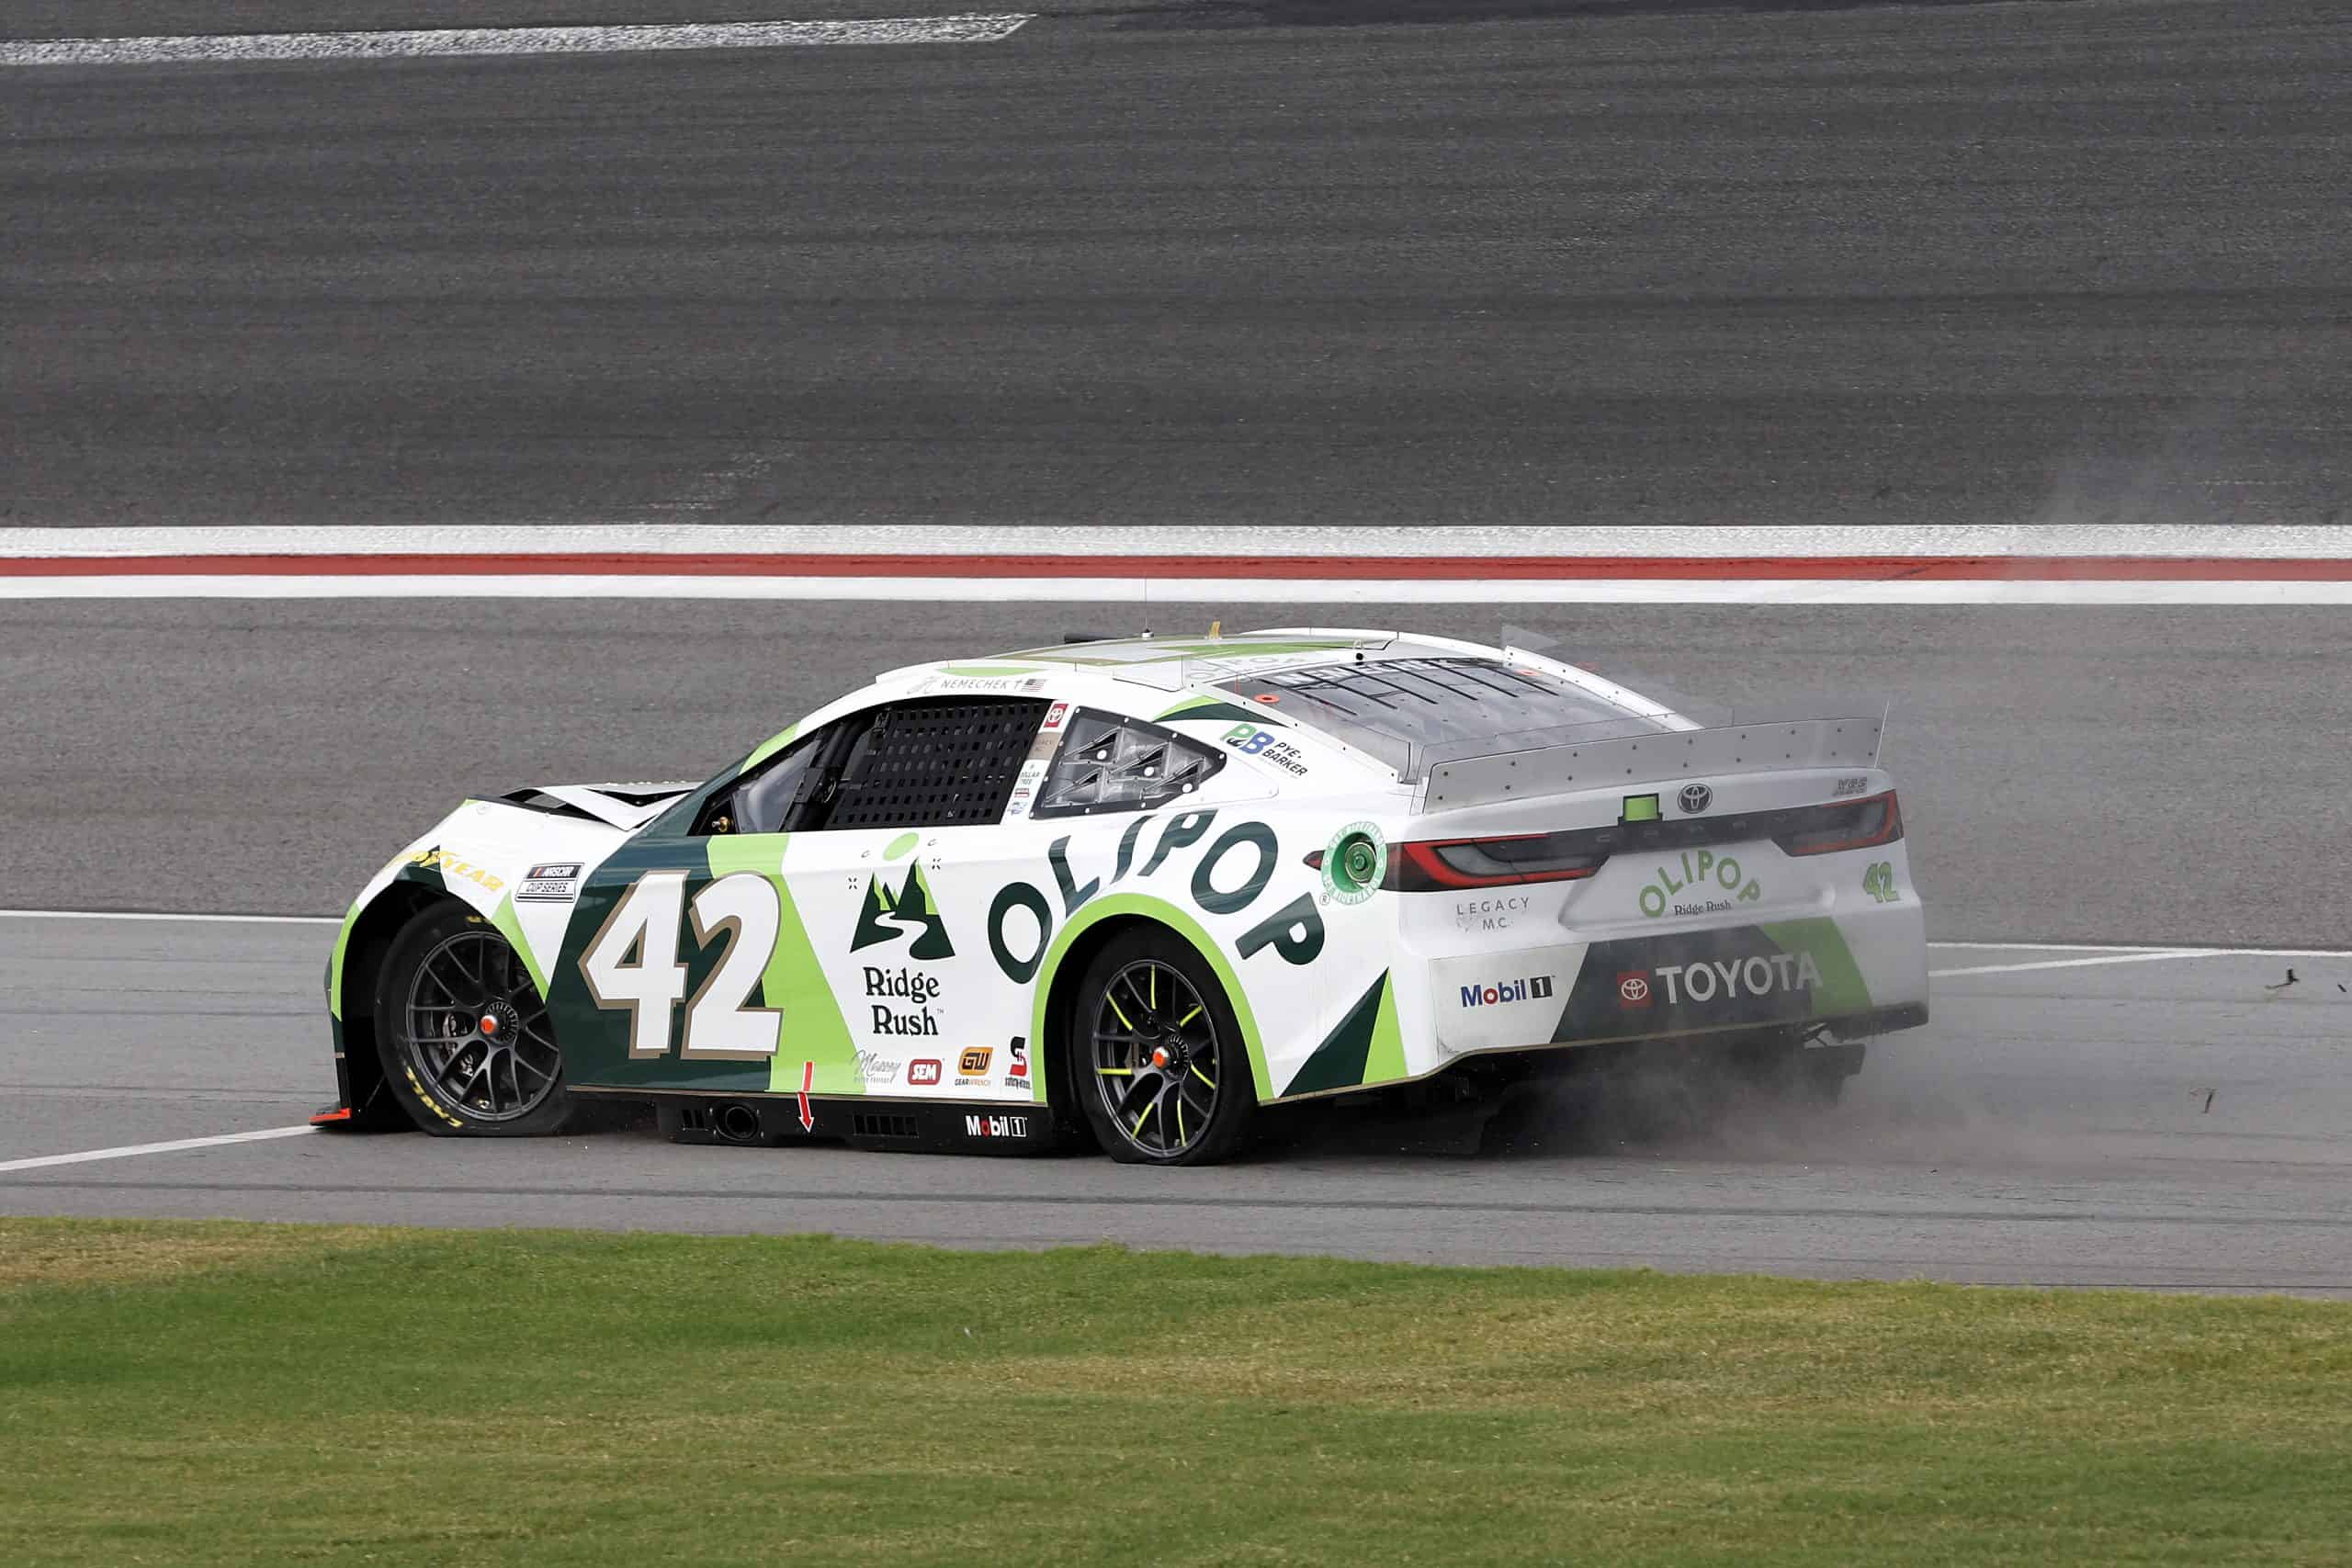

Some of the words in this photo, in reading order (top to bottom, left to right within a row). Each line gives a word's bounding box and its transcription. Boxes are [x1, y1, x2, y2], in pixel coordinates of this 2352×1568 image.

[940, 678, 1011, 689] NEMECHEK
[1261, 749, 1308, 776] BARKER
[386, 850, 504, 892] ODYEAR
[1639, 850, 1761, 918] OLIPOP
[1862, 861, 1901, 904] 42
[526, 882, 542, 893] CUP
[543, 882, 570, 893] SERIES
[988, 809, 1325, 984] OLIPOP
[1456, 897, 1530, 915] LEGACY
[1674, 900, 1704, 917] Ridge
[1706, 898, 1733, 913] Rush
[577, 868, 785, 1061] 42
[1656, 951, 1824, 1005] TOYOTA
[862, 966, 941, 1004] Ridge
[1460, 978, 1527, 1008] Mobil
[870, 1004, 939, 1036] Rush
[910, 1064, 937, 1081] SEM
[966, 1114, 1010, 1137] Mobil
